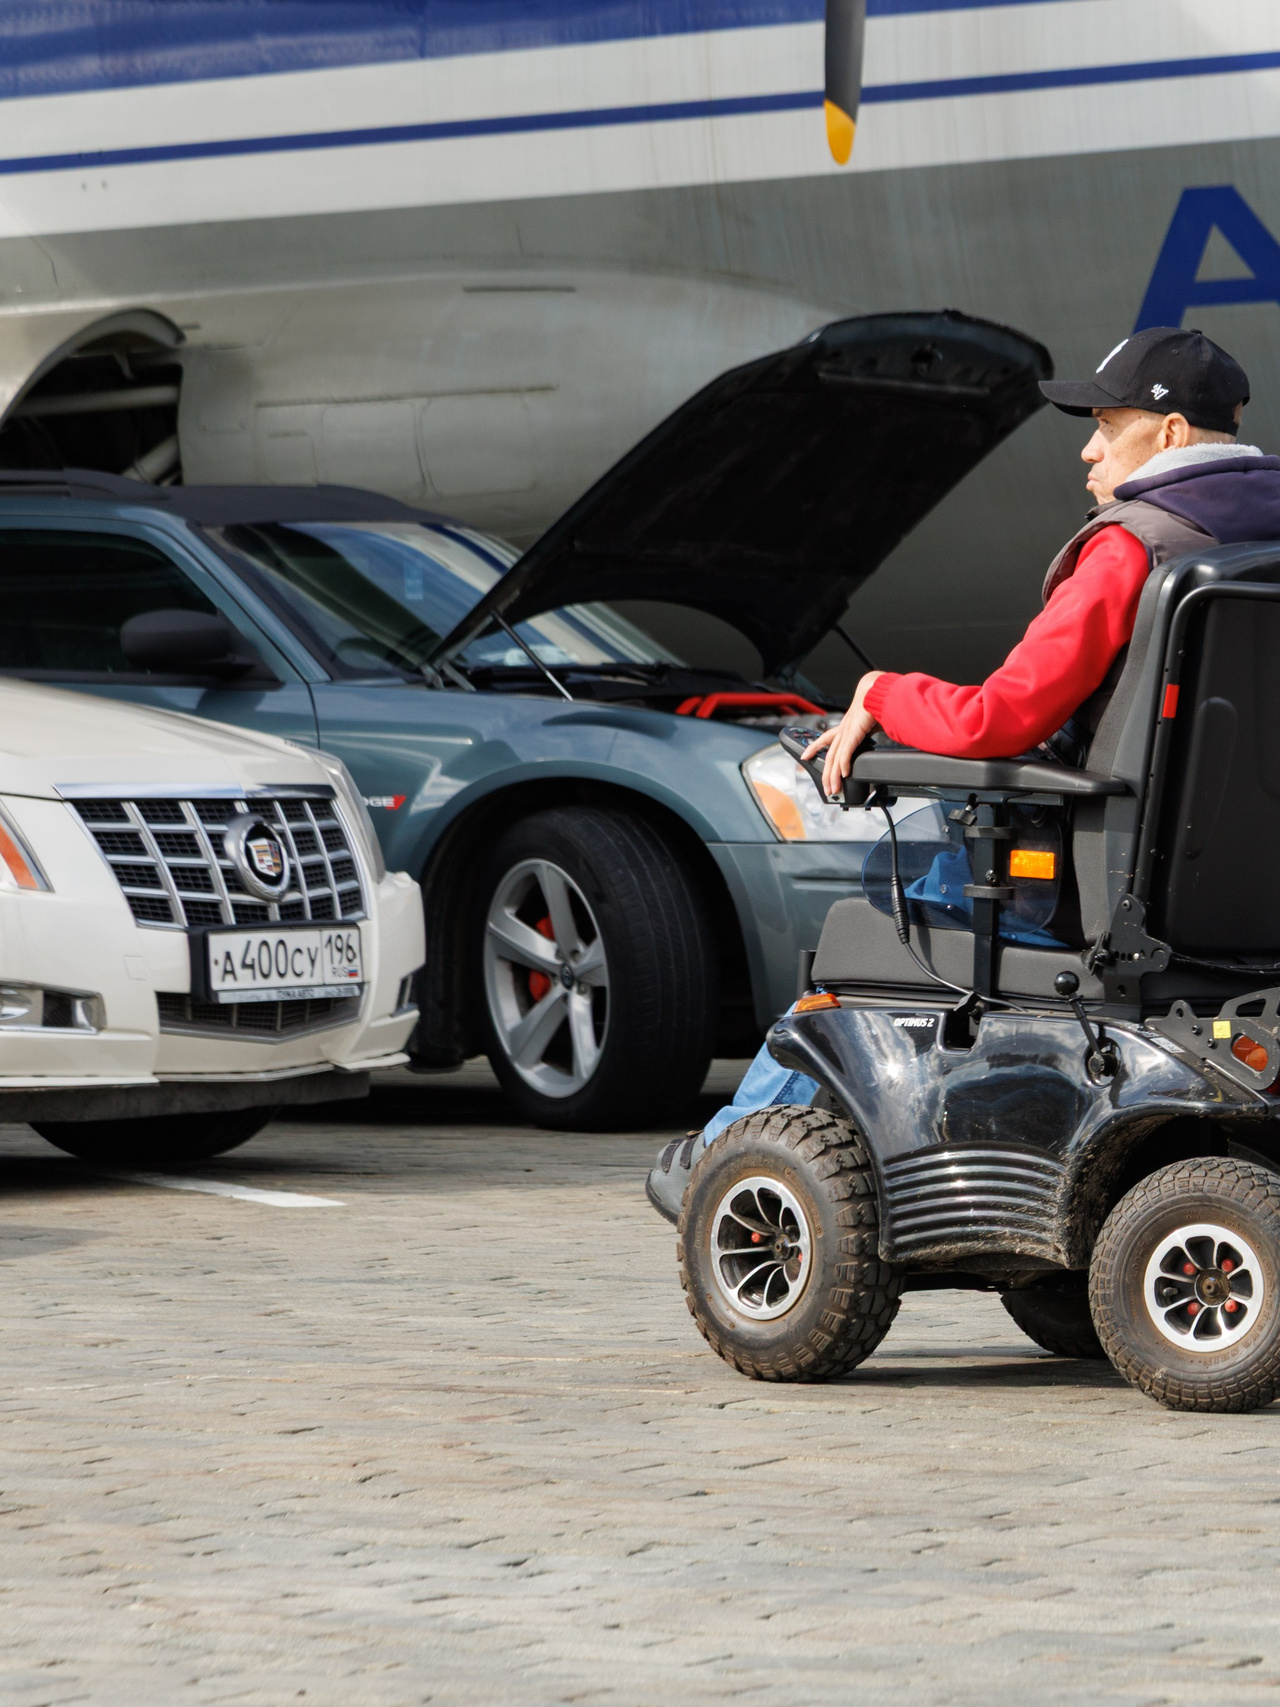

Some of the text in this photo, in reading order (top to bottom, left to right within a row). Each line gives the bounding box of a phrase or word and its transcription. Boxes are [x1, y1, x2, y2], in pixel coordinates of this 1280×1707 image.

[325, 934, 357, 964] 196
[332, 966, 348, 978] RUS
[893, 1017, 935, 1028] OPTIMUS 2
